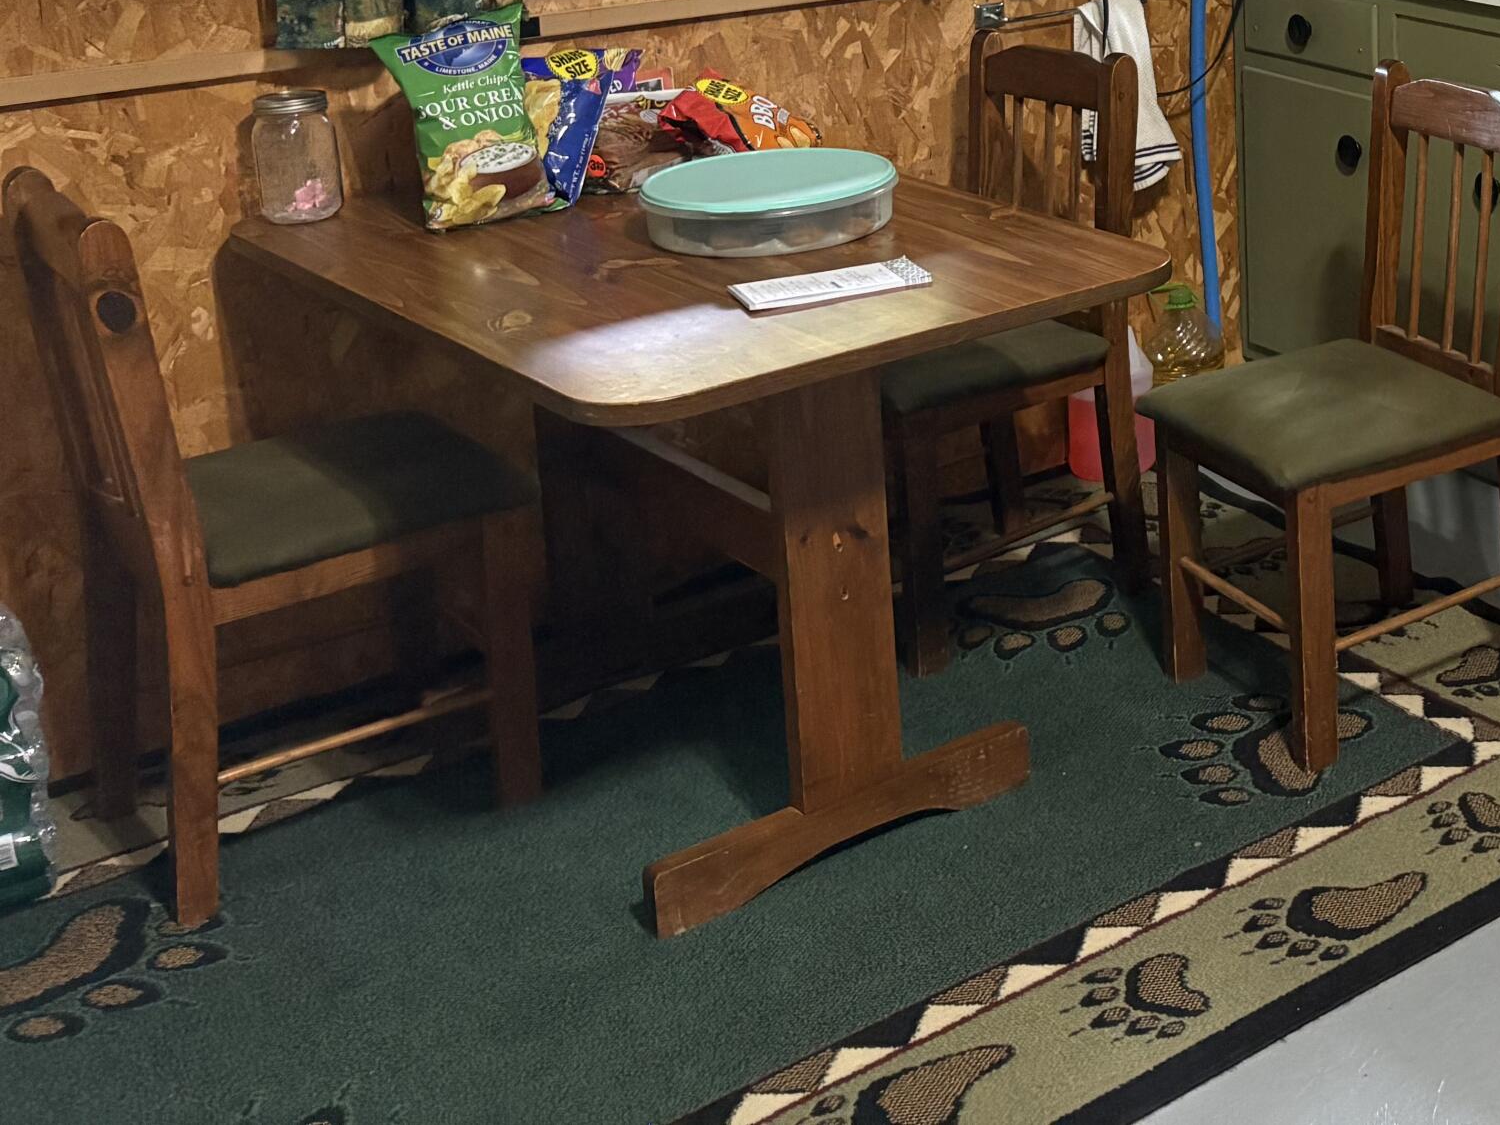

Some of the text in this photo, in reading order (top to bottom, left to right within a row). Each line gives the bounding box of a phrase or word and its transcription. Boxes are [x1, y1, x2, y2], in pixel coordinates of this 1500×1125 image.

[401, 24, 513, 62] TASTE OF MAINE
[435, 54, 497, 75] LIMESTONE, MAINE
[549, 49, 588, 68] SHARE
[565, 59, 593, 80] SIZE
[443, 74, 509, 94] Kettle Chips
[417, 87, 524, 119] SOUR CREA
[750, 95, 778, 131] BBQ
[439, 102, 525, 130] & ONION
